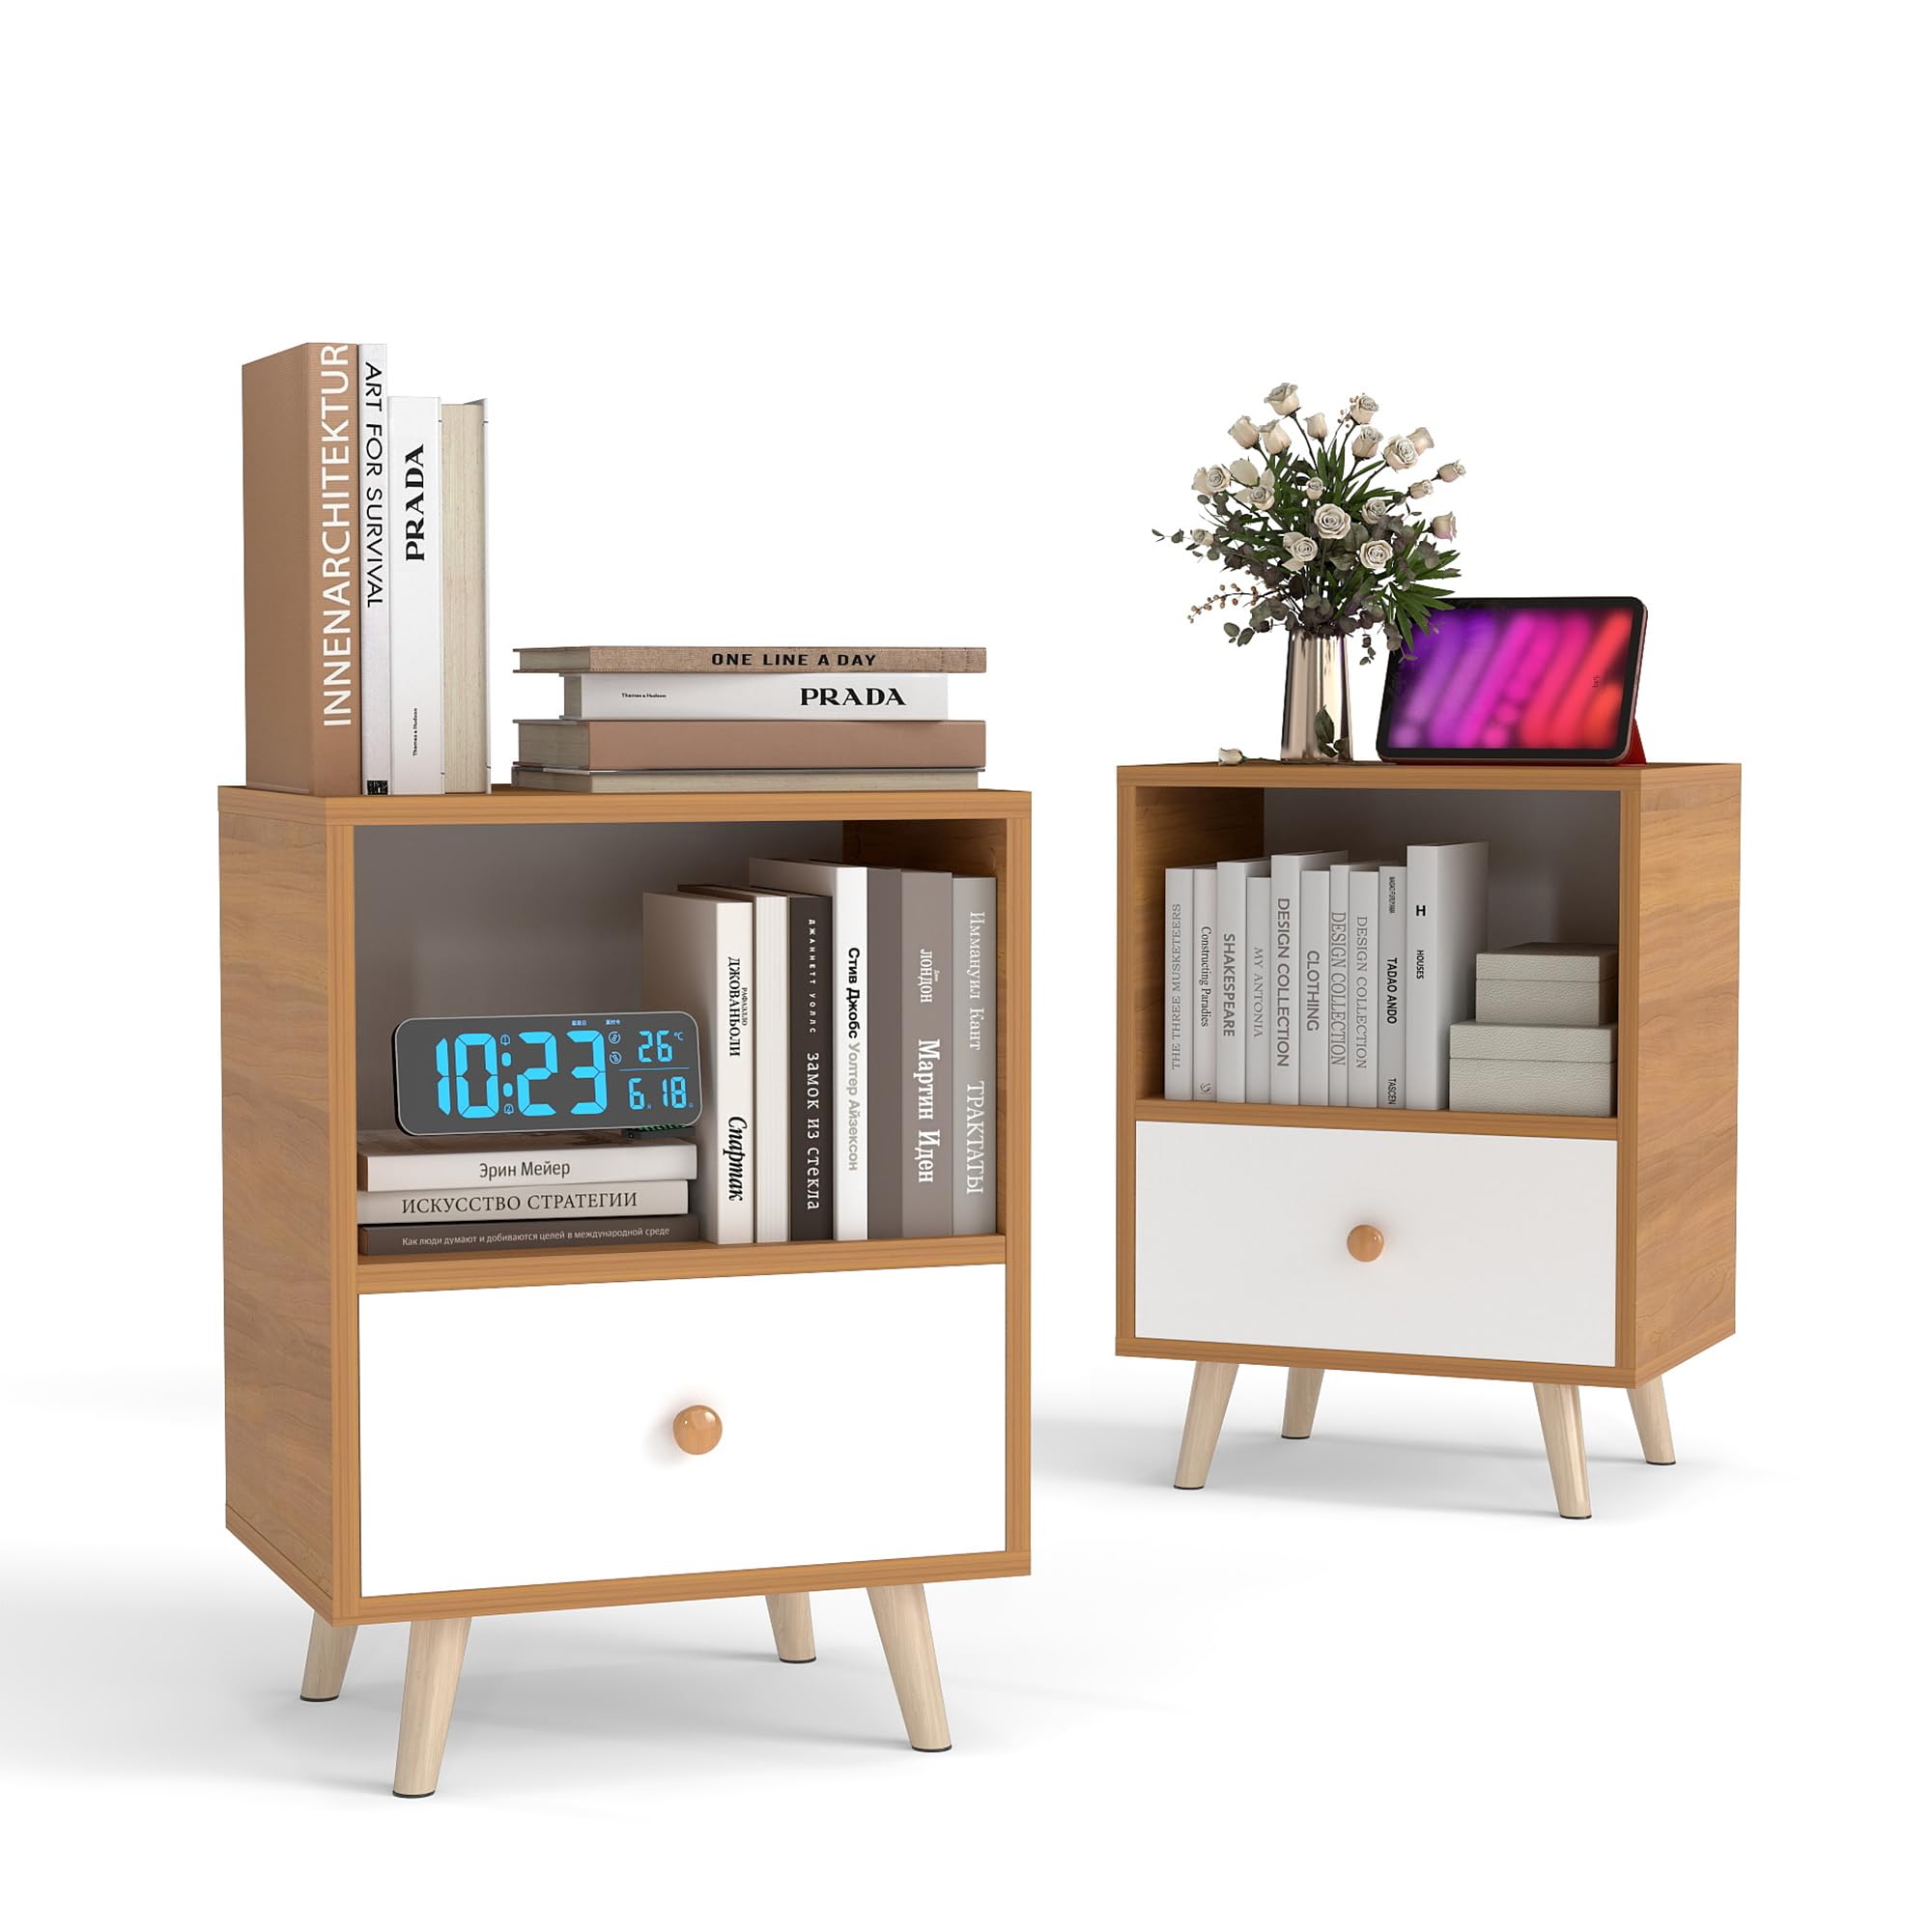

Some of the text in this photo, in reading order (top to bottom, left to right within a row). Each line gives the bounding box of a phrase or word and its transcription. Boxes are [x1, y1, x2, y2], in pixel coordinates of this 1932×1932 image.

[366, 361, 383, 608] ART FOR SURVIVAL
[405, 444, 425, 561] PRADA
[321, 344, 352, 725] INNENARCHITEKTUR
[711, 654, 876, 666] ONE LINE A DAY
[801, 688, 906, 705] PRADA
[1416, 905, 1426, 916] H
[727, 957, 740, 1056] ДЖОВАНЬОЛИ
[918, 949, 932, 1004] ЛОНДОН
[1172, 997, 1180, 1039] THREE
[1200, 926, 1211, 1027] Constructing Paradies
[1223, 933, 1235, 1037] SHAKESPEARE
[1254, 948, 1264, 1037] MY ANTONIA
[1277, 897, 1290, 1066] DESIGN COLLECTION
[1307, 951, 1320, 1032] CLOTHING
[1330, 912, 1346, 1065] DESIGN COLLECTION
[1356, 917, 1367, 1068] DESIGN COLLECTION
[1387, 958, 1397, 1024] TADAO ANDO
[436, 1030, 608, 1119] 10:23
[847, 948, 861, 1171] Стив Джобс Уолтер Айзексон
[967, 911, 985, 1194] Иммануил Кант ТРАКТАТЫ
[1172, 1043, 1180, 1069] THE
[1387, 1078, 1396, 1104] TASCEN
[914, 1038, 940, 1182] Мартин Иден
[402, 1192, 638, 1213] ИСКУССТВО СТРАТЕГИИ
[479, 1161, 570, 1181] Эрин Мейер
[724, 1116, 747, 1201] Спартак
[419, 1236, 442, 1245] люди
[444, 1236, 477, 1245] думают
[487, 1234, 537, 1243] добиваются
[540, 1232, 564, 1240] целей
[575, 1228, 642, 1239] международной
[645, 1228, 669, 1236] среде
